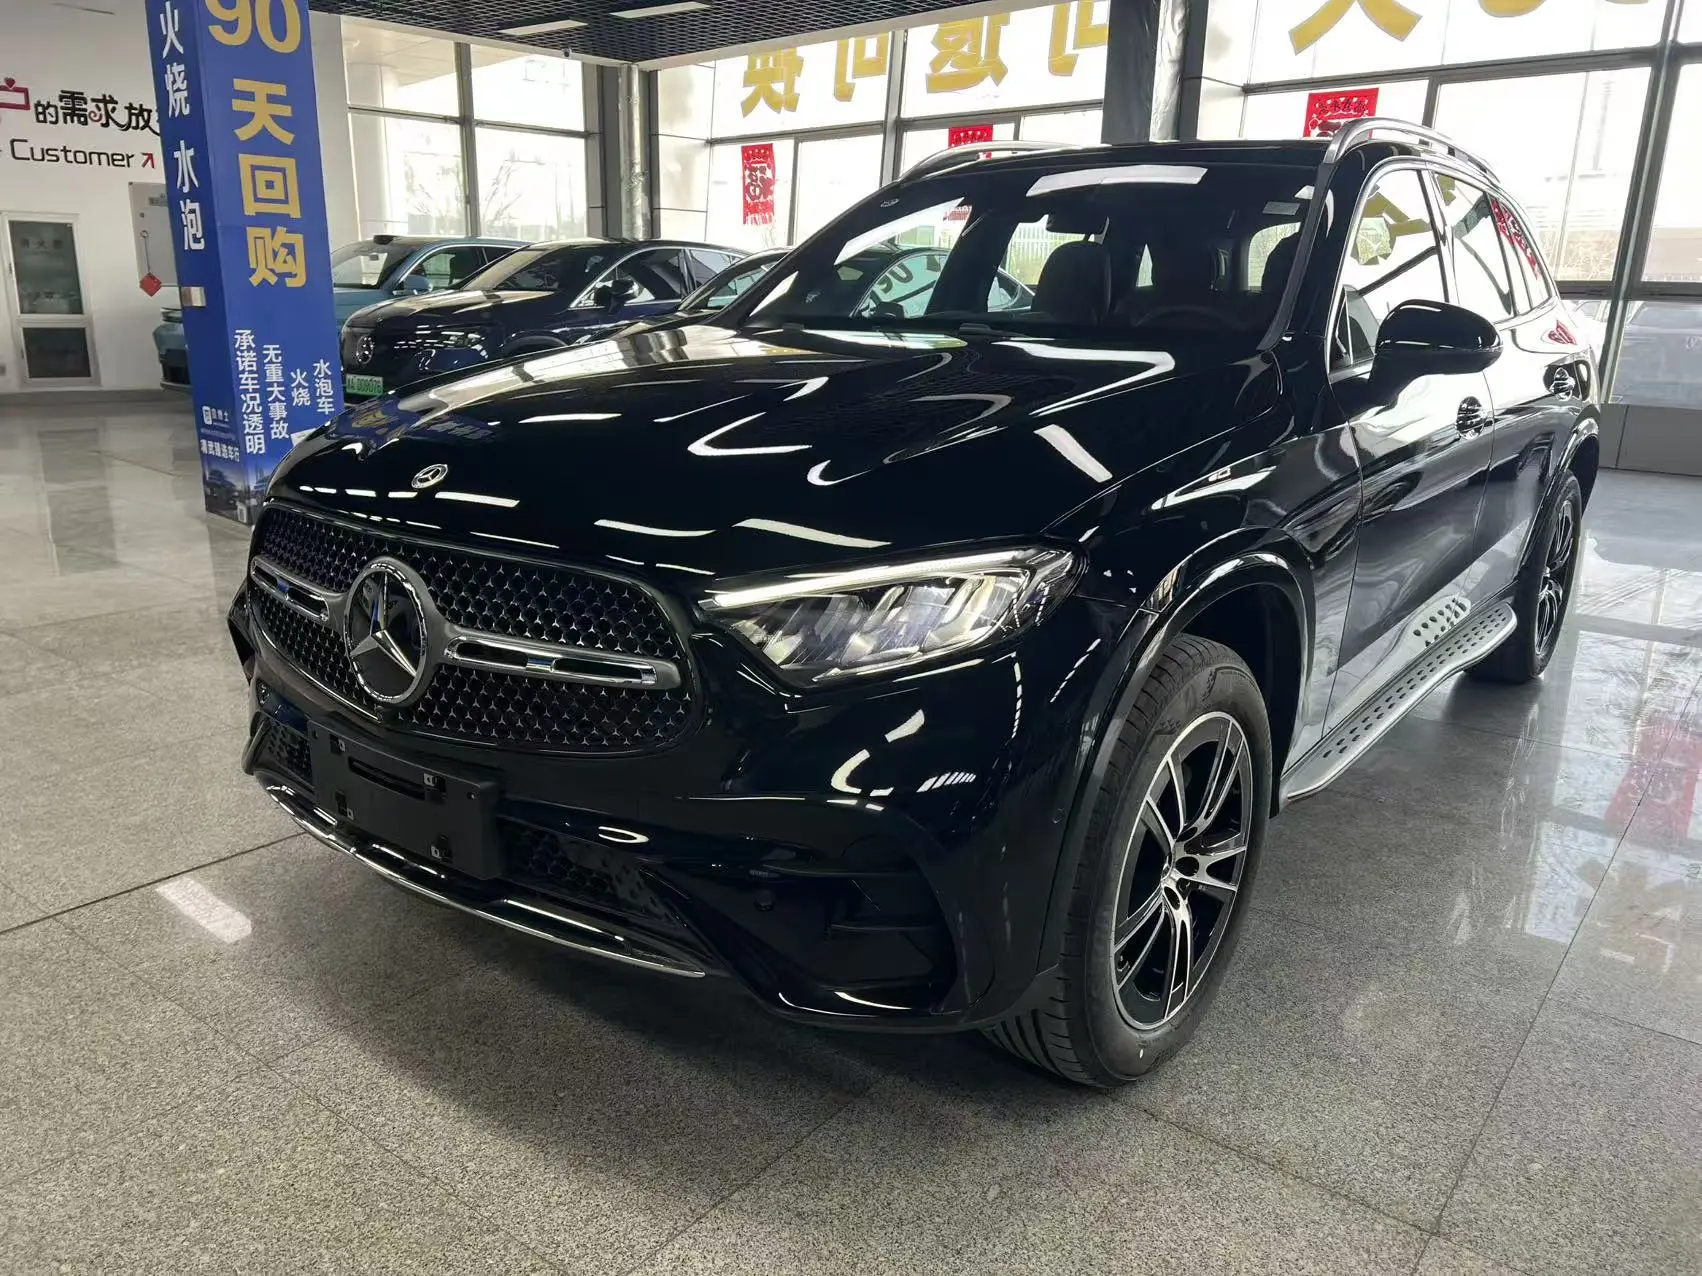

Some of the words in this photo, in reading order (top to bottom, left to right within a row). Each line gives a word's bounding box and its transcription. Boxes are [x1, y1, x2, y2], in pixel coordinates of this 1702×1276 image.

[160, 1, 190, 117] 火烧
[9, 138, 135, 168] Customer
[173, 140, 205, 250] 水泡
[234, 329, 266, 455] 承诺车况透明
[262, 344, 290, 440] 无重大事故
[290, 369, 311, 407] 火烧
[312, 359, 335, 415] 水泡车
